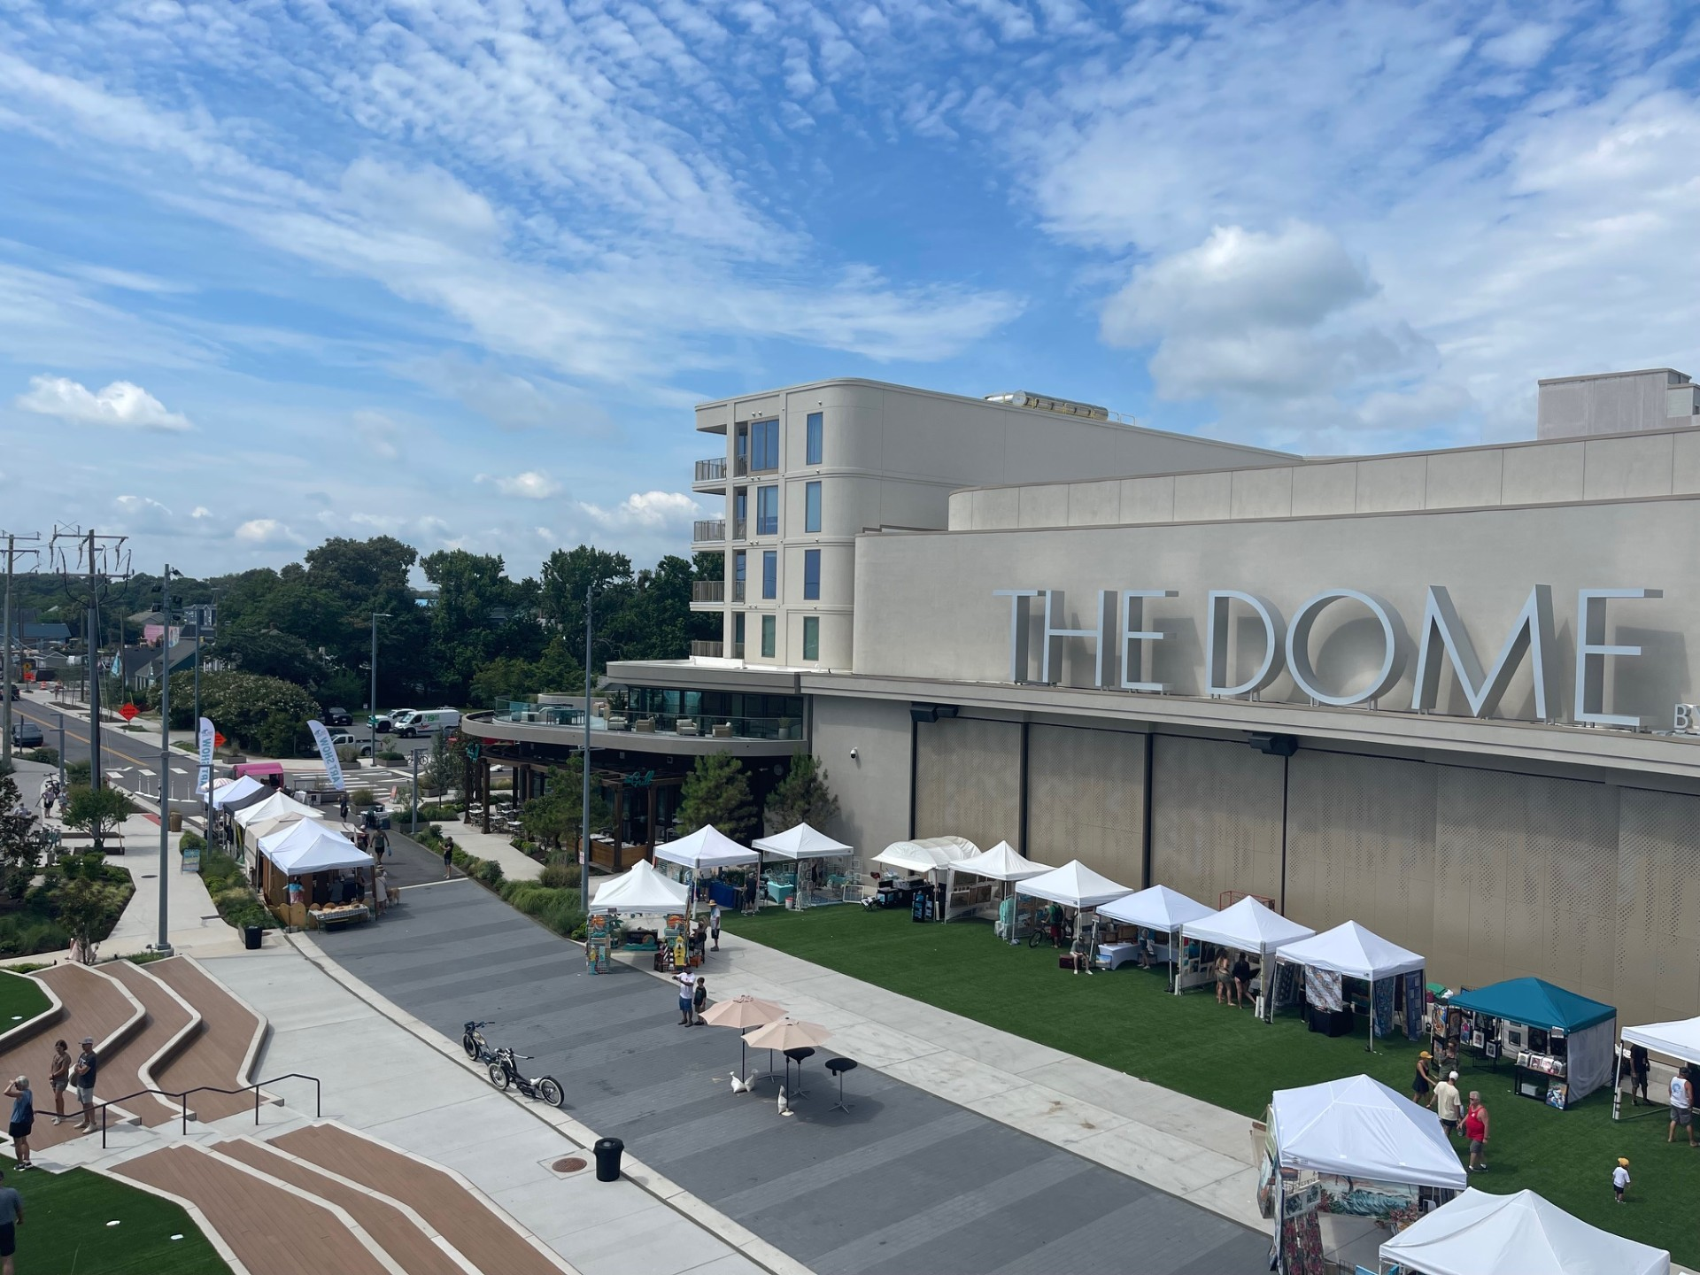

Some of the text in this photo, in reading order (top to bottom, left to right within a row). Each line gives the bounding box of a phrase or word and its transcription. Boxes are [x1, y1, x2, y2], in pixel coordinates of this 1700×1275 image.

[992, 584, 1661, 726] THE DOME
[1674, 703, 1700, 729] B
